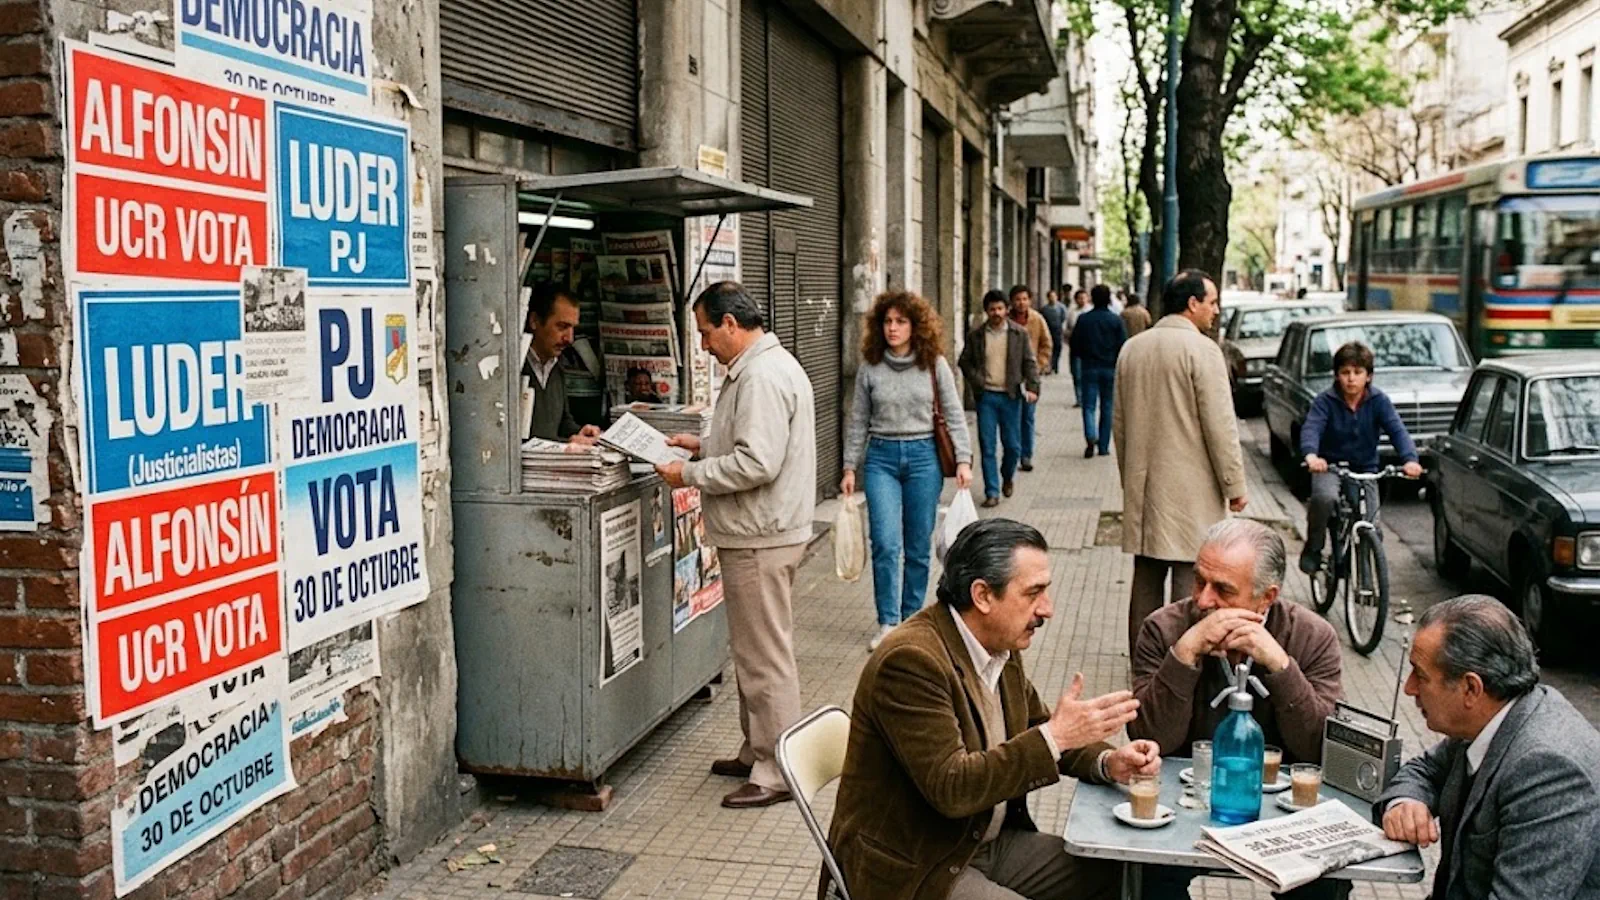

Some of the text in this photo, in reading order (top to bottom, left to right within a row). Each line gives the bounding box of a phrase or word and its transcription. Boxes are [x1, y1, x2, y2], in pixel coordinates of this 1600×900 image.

[80, 77, 262, 181] ALFONSÍN
[288, 139, 400, 227] LUDER
[94, 196, 254, 266] UCR VOTA
[330, 229, 367, 274] PJ
[103, 339, 254, 440] LUDER
[319, 307, 374, 403] PJ
[128, 436, 242, 487] (Justicialistas)
[291, 404, 407, 460] DEMOCRACIA
[103, 479, 271, 597] ALFONSÍN
[308, 464, 400, 556] VOTA
[293, 541, 420, 623] 30 DE OCTUBRE
[117, 618, 187, 693] UCR
[193, 592, 268, 664] VOTA
[141, 752, 274, 853] 30 DE OCTUBRE
